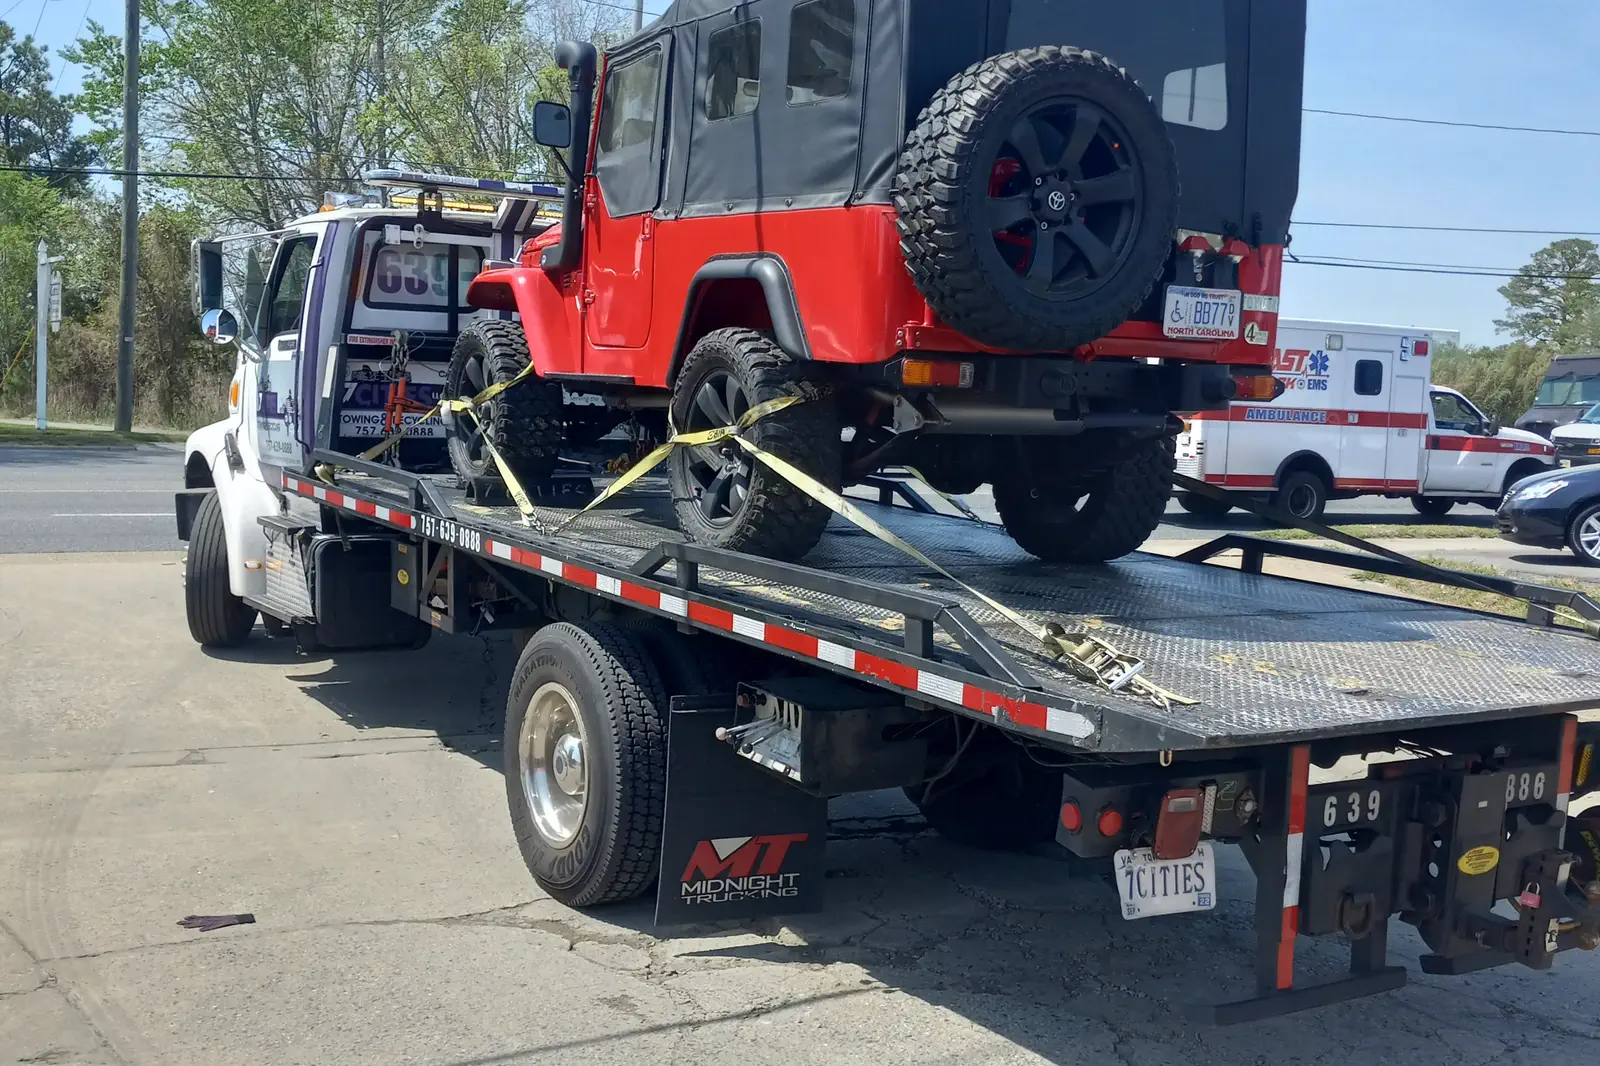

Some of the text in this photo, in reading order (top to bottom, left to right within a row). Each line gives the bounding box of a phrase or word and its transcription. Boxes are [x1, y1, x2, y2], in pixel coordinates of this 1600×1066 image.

[1194, 301, 1228, 325] BB77
[359, 337, 389, 345] EXTINGUISHER
[1167, 327, 1235, 337] NORTH CAROLINA
[1307, 378, 1328, 391] EMS
[1245, 408, 1328, 423] AMBULANCE
[421, 514, 481, 553] 757-639-0888
[680, 833, 809, 881] MT
[681, 873, 800, 896] MIDNIGHT
[1125, 862, 1205, 901] 7CITIES
[681, 887, 798, 905] TRUCKING
